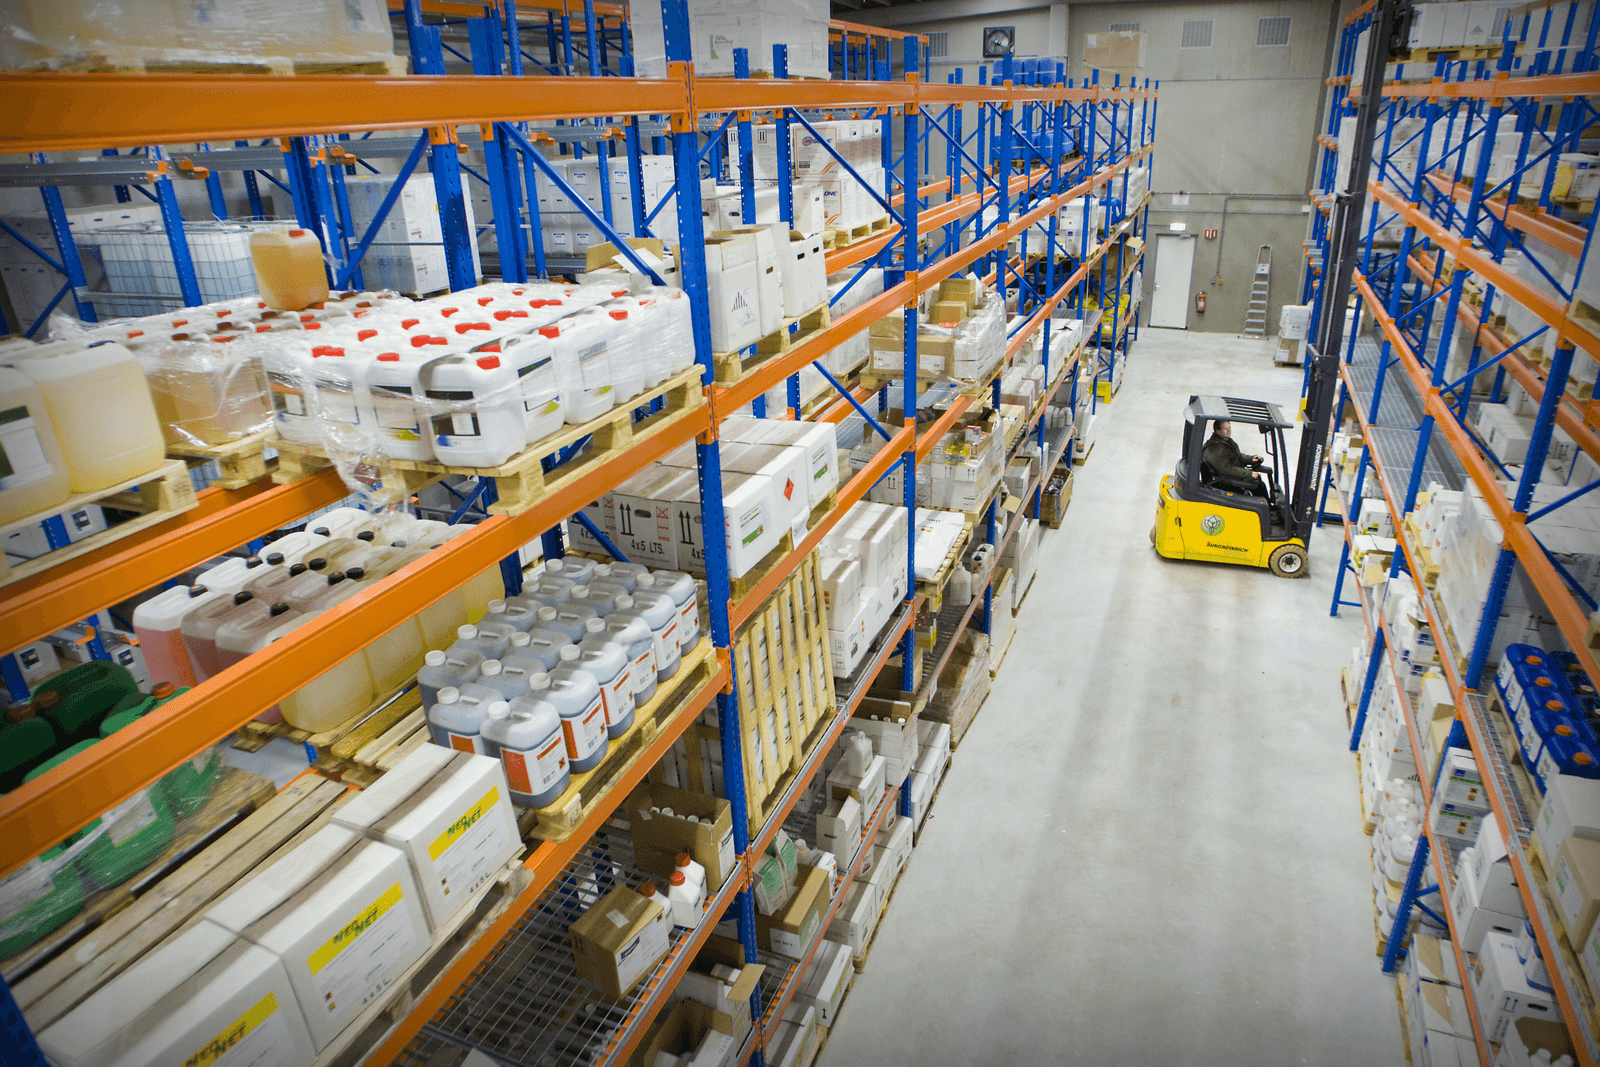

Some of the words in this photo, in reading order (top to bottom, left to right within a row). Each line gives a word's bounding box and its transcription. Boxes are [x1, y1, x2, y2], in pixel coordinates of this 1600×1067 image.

[1309, 444, 1323, 491] JUNGHEINRICH
[631, 539, 646, 551] 4x5
[649, 542, 665, 555] LTS.
[1206, 541, 1249, 553] JUNGHEINRICH
